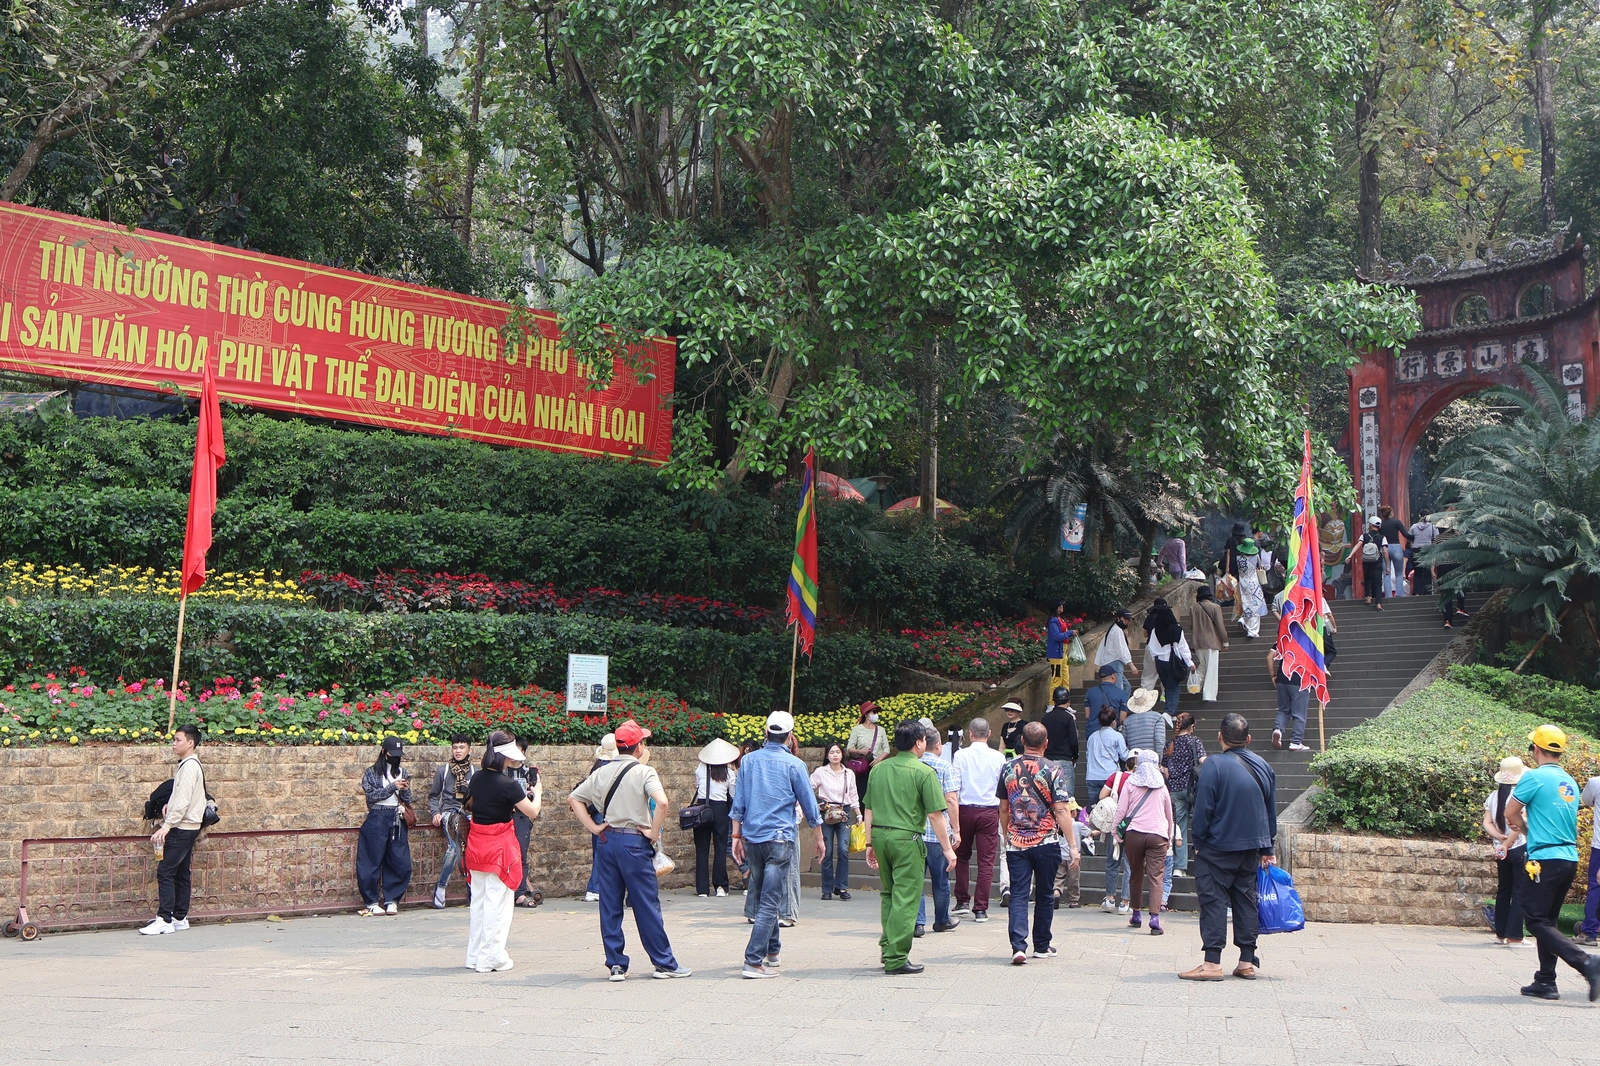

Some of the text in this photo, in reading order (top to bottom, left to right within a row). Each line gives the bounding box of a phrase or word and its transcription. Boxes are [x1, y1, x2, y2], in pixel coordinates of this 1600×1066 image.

[39, 235, 85, 287] TÍN
[93, 251, 209, 309] NGƯỠNG
[217, 271, 268, 319] THỜ
[273, 282, 342, 333] CÚNG
[349, 296, 415, 346] HÙNG
[423, 313, 498, 361] VƯƠNG
[0, 293, 645, 450] I SẢN VĂN HÓA PHI VẬT THỂ ĐẠI DIỆN CỦA NHÂN LOẠI
